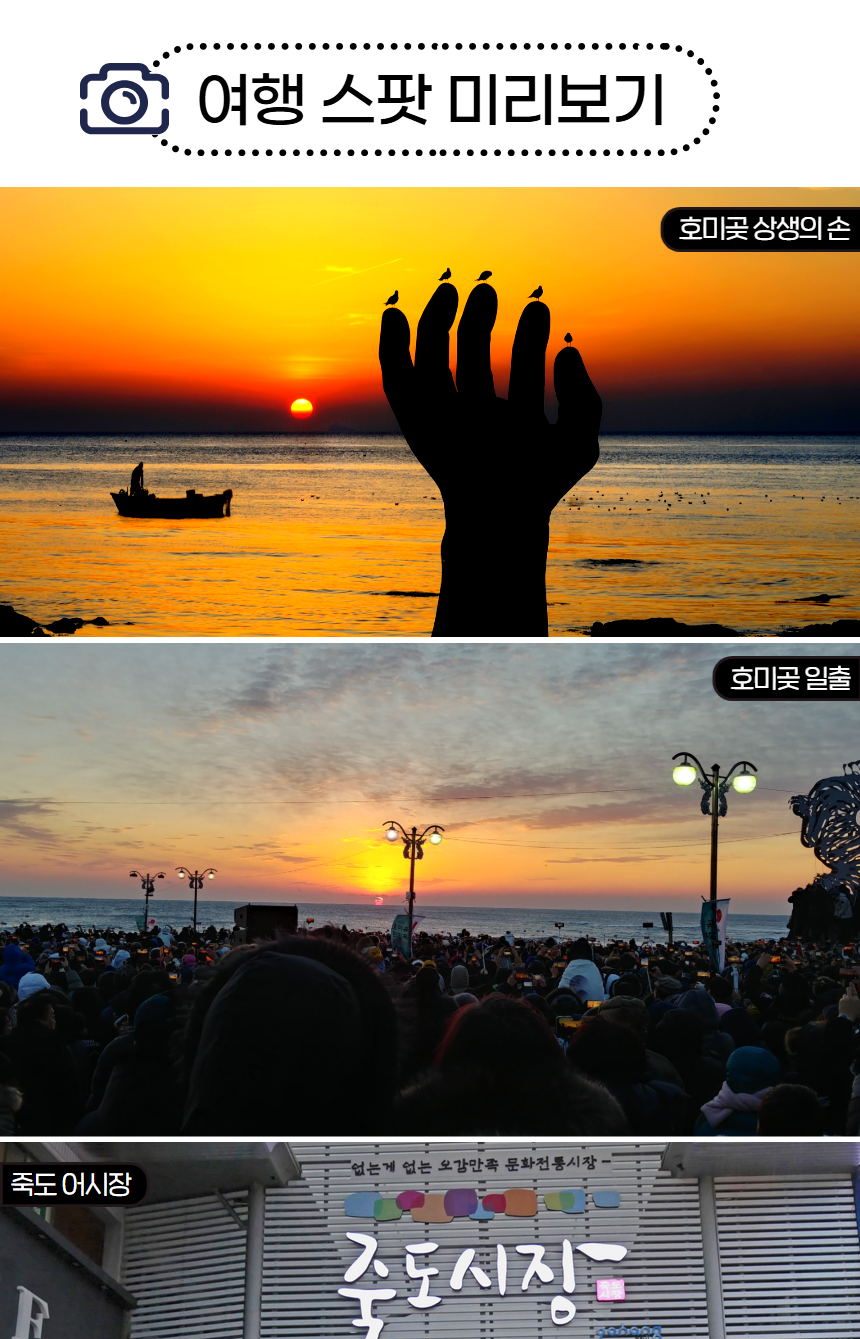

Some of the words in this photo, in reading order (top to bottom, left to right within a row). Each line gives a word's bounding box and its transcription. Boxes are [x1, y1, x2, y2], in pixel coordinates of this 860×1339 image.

[351, 1160, 396, 1176] 없는게
[402, 1159, 433, 1175] 없는
[438, 1157, 499, 1174] 오감만족
[504, 1155, 598, 1172] 문화전통시장
